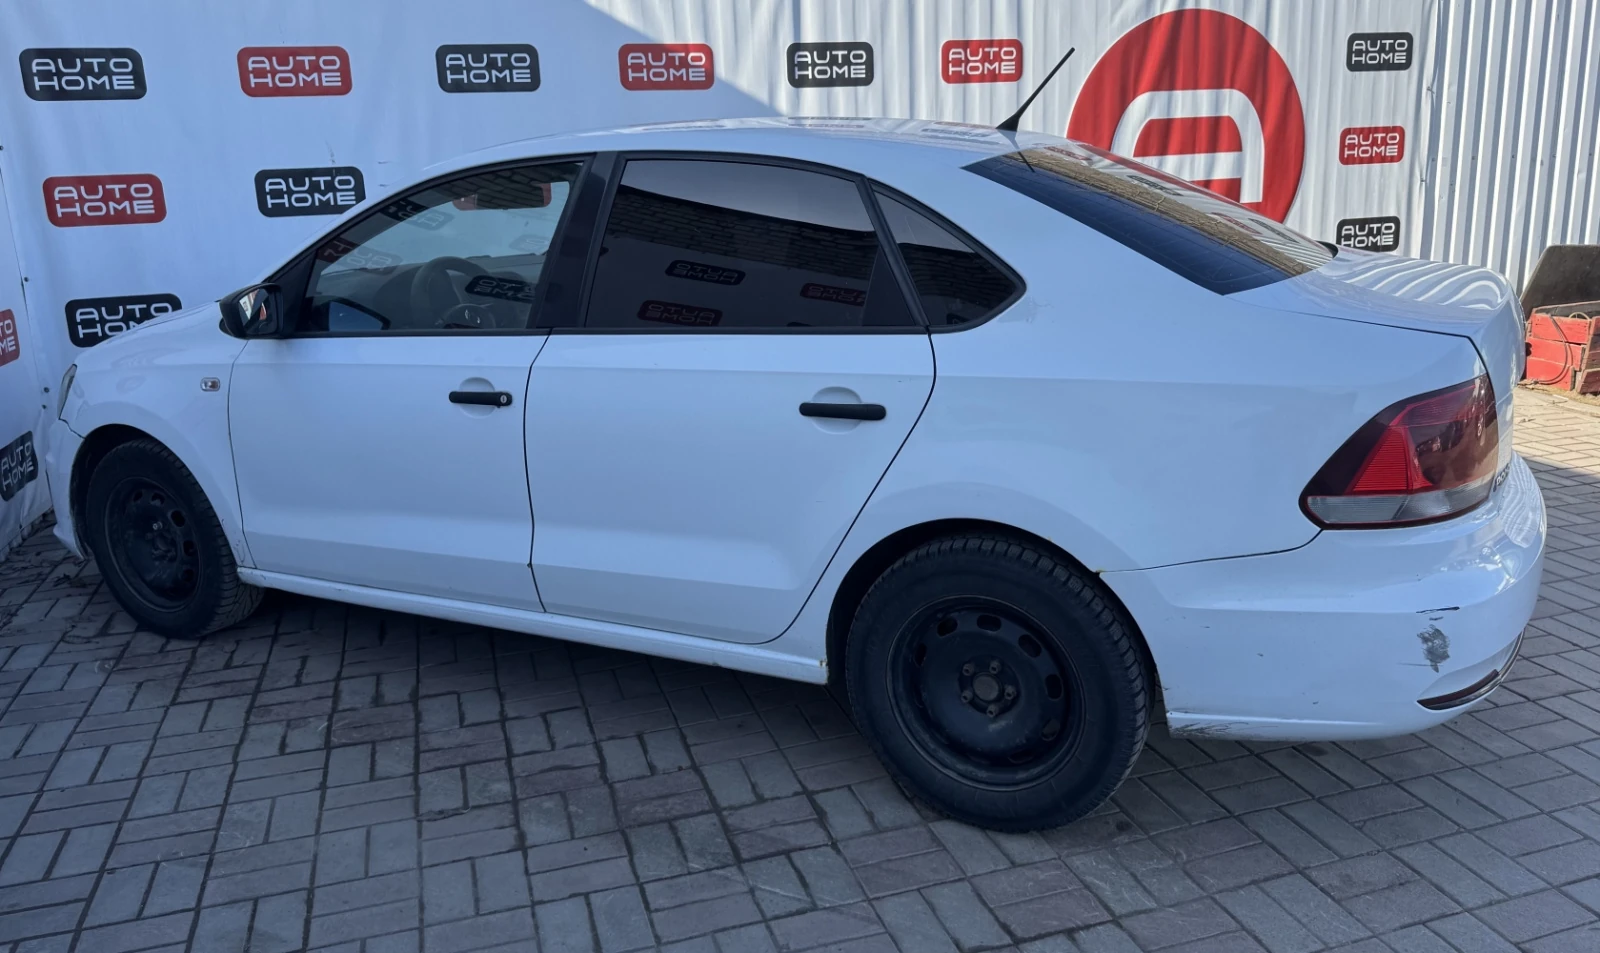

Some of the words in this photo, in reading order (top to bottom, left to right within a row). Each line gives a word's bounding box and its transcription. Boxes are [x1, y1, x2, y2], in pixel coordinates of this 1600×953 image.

[1352, 40, 1408, 52] AUTO
[445, 54, 531, 67] AUTO
[627, 52, 706, 66] AUTO
[795, 51, 867, 64] AUTO
[948, 47, 1016, 61] AUTO
[1351, 52, 1407, 65] HOME
[32, 58, 133, 74] AUTO
[247, 56, 341, 71] AUTO
[948, 62, 1016, 75] HOME
[447, 70, 532, 83] HOME
[627, 68, 706, 82] HOME
[795, 65, 866, 79] HOME
[34, 76, 136, 91] HOME
[249, 72, 342, 88] HOME
[1345, 133, 1400, 146] AUTO
[1344, 145, 1399, 158] HOME
[265, 176, 355, 193] AUTO
[53, 184, 154, 201] AUTO
[266, 192, 357, 209] HOME
[55, 200, 156, 218] HOME
[1341, 222, 1396, 237] AUTO
[1340, 234, 1394, 248] HOME
[75, 302, 173, 323] AUTO
[0, 336, 16, 355] ME
[1, 441, 32, 474] AUTO
[2, 457, 35, 491] HOME
